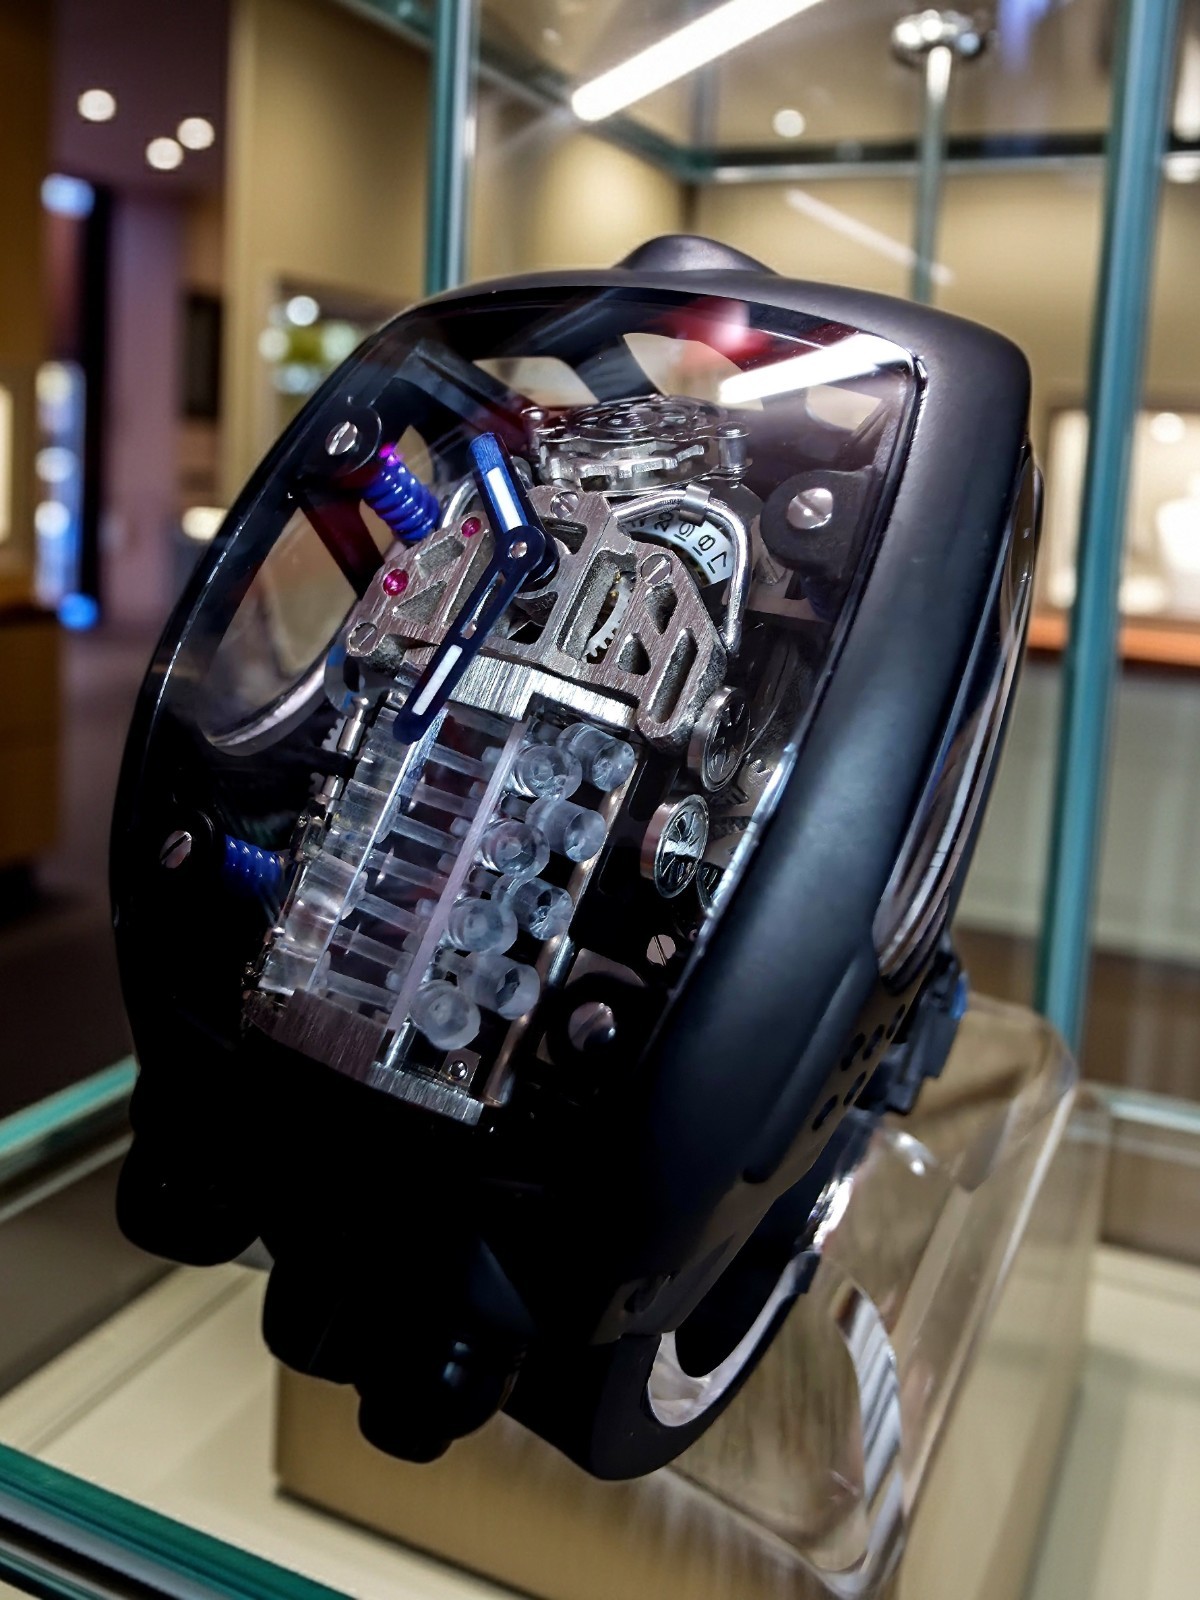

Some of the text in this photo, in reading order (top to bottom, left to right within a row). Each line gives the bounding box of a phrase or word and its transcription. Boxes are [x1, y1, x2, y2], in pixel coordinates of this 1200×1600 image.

[674, 523, 696, 542] 19
[692, 534, 716, 557] 18
[707, 551, 728, 574] 17
